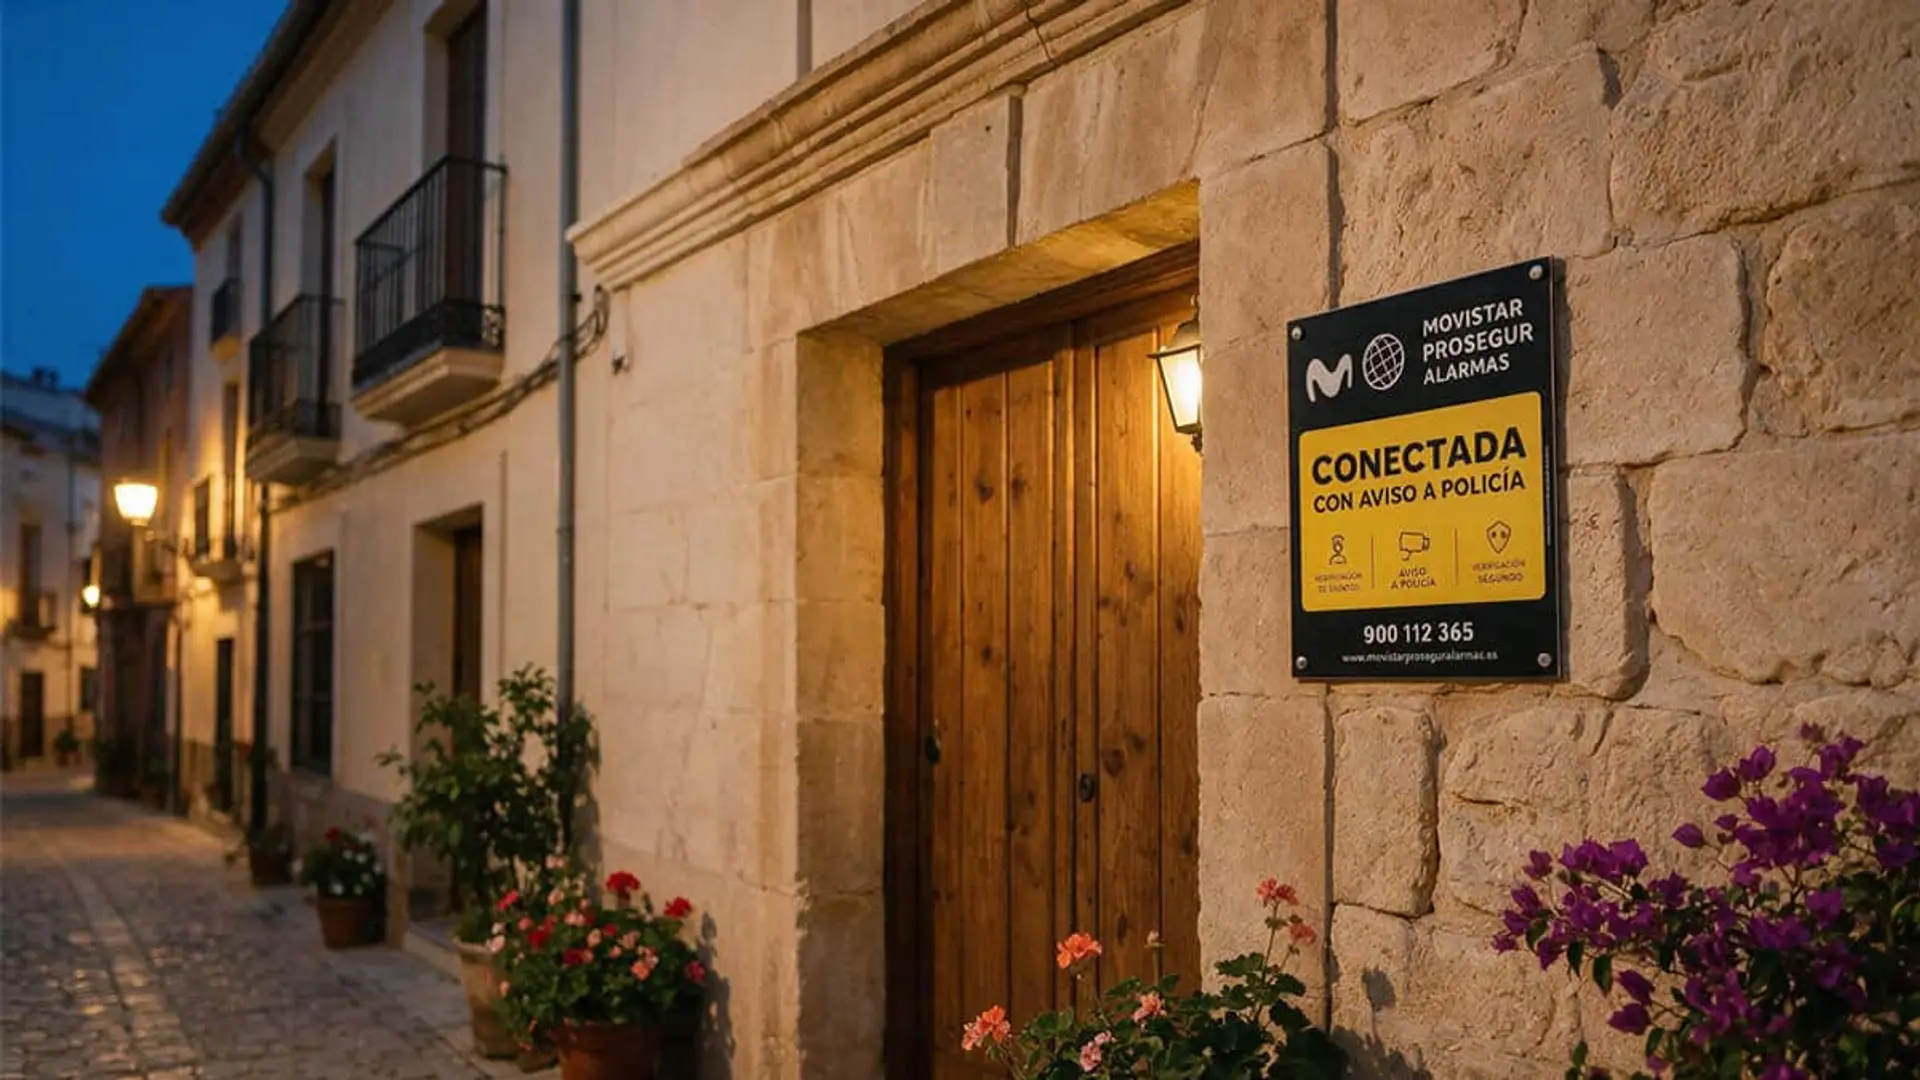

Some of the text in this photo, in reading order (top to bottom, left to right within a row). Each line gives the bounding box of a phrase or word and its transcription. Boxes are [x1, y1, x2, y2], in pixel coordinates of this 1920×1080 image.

[1422, 298, 1523, 338] MOVISTAR
[1423, 322, 1534, 363] PROSEGUR
[1423, 352, 1510, 386] ALARMAS
[1312, 427, 1527, 486] CONECTADA
[1313, 466, 1526, 514] CON AVISO A POLICÍA
[1391, 580, 1398, 589] A
[1400, 566, 1427, 577] AVISO
[1363, 621, 1474, 644] 900 112 365
